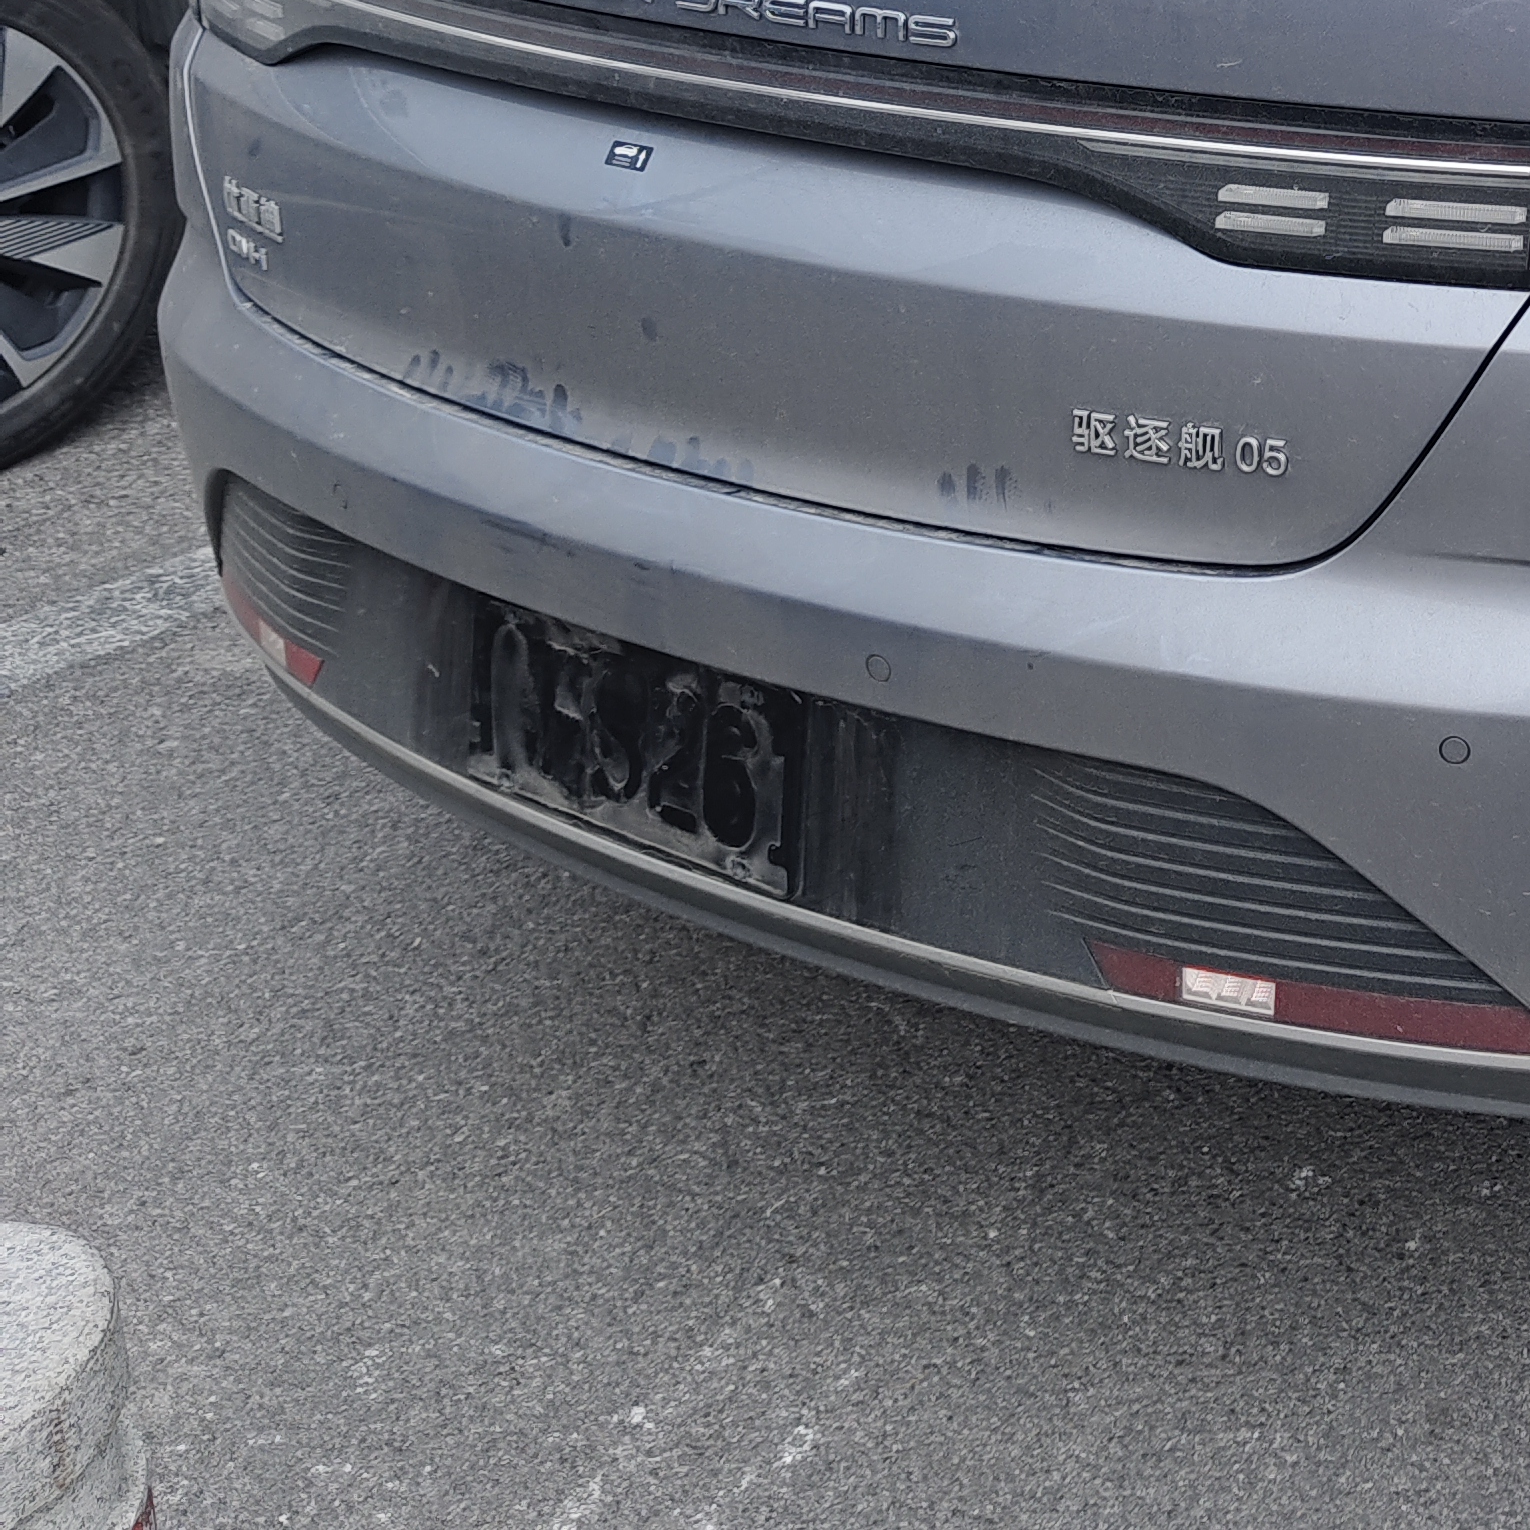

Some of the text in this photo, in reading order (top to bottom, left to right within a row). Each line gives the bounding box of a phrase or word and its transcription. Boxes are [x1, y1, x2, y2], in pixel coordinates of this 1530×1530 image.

[223, 175, 284, 237] 比亚迪
[1071, 407, 1289, 477] 驱逐舰 05
